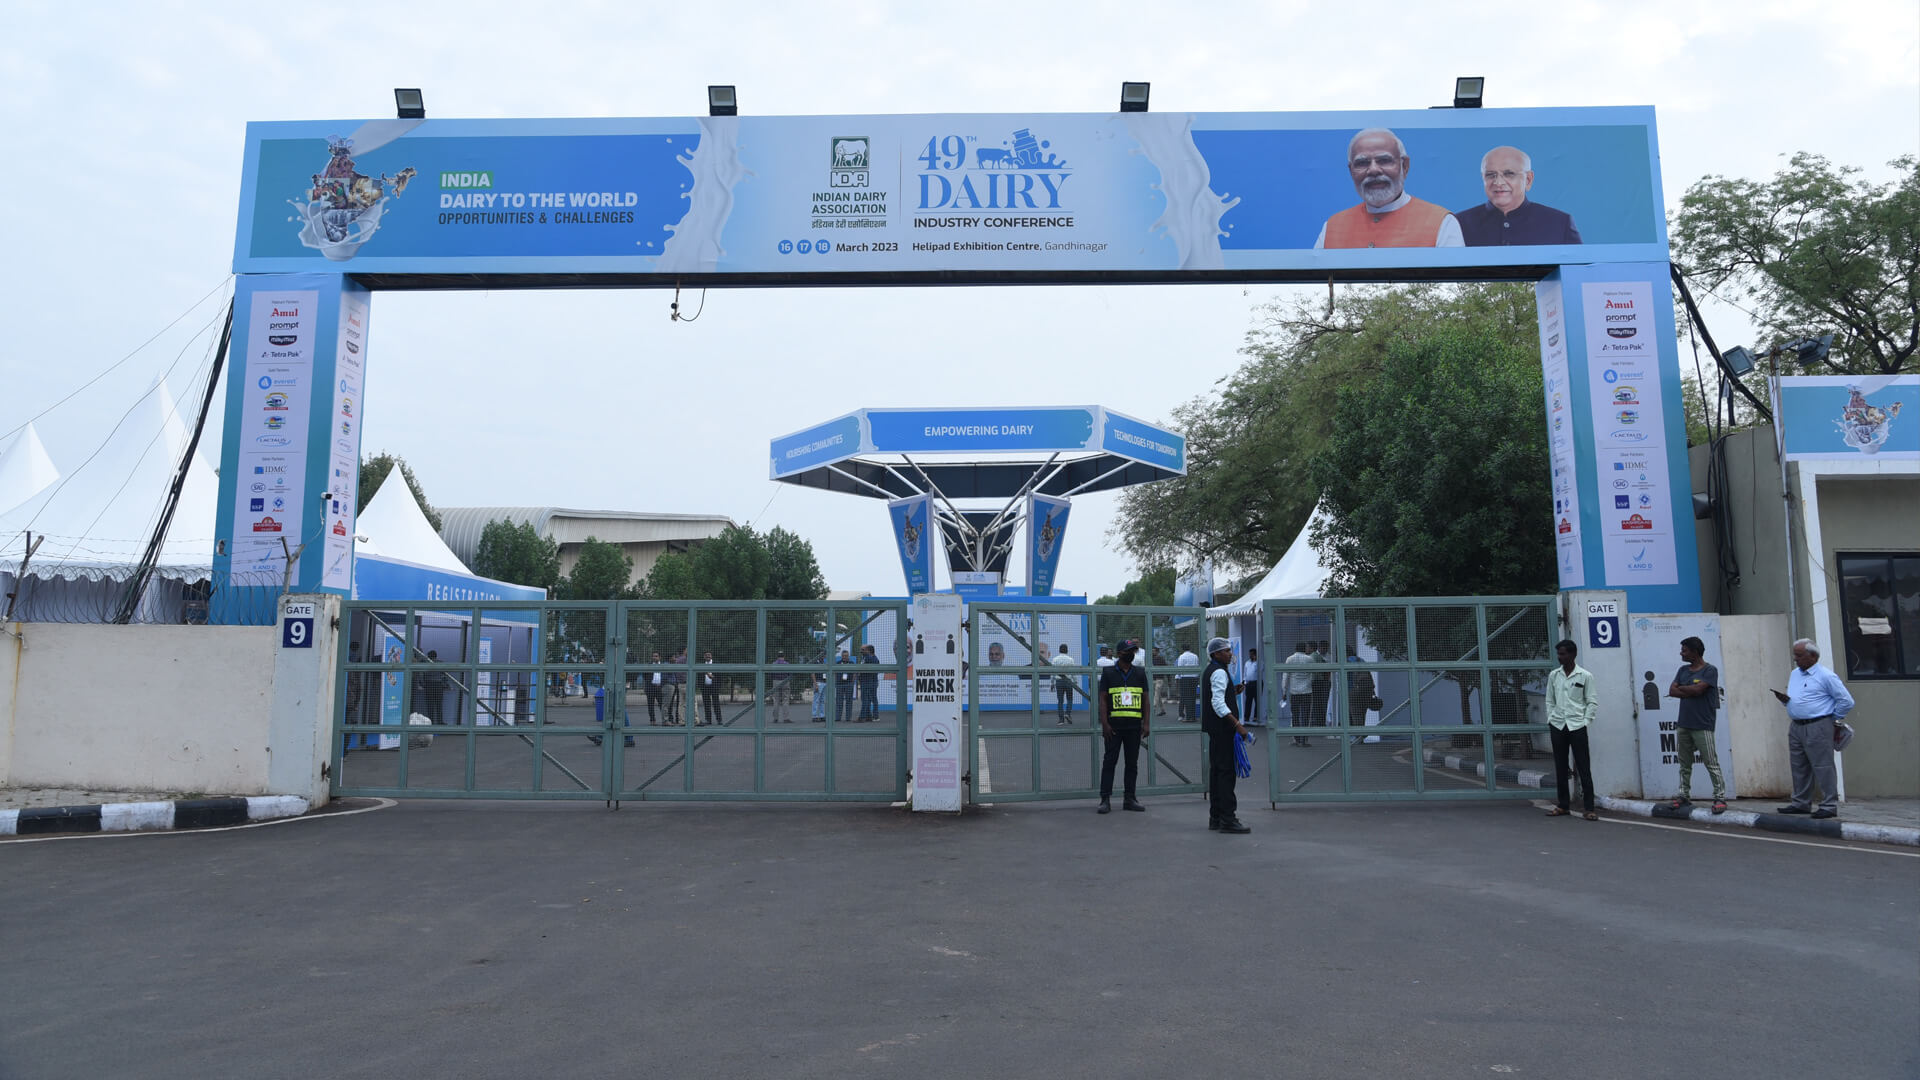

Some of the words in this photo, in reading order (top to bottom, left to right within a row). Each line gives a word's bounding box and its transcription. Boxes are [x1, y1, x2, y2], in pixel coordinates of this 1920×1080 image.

[441, 173, 491, 187] INDIA
[918, 173, 1073, 209] DAIRY
[440, 193, 498, 208] DAIRY
[500, 193, 525, 208] TO
[529, 192, 565, 208] THE
[569, 192, 638, 207] WORLD
[812, 192, 850, 202] INDIAN
[854, 192, 887, 202] DAIRY
[811, 204, 887, 214] ASSOCIATION
[438, 212, 535, 225] OPPORTUNITIES
[539, 212, 547, 224] &
[554, 211, 634, 224] CHALLENGES
[914, 217, 980, 228] INDUSTRY
[984, 217, 1074, 228] CONFERENCE
[836, 242, 869, 252] March
[871, 242, 898, 252] 2023
[912, 242, 950, 253] Helipad
[953, 241, 1003, 251] Exhibition
[1006, 242, 1042, 252] Centre,
[1045, 241, 1109, 253] Gandhinagar
[1605, 299, 1634, 309] Amul
[271, 308, 298, 317] Amul
[270, 322, 299, 330] prompt
[924, 425, 999, 437] EMPOWERING
[1001, 424, 1034, 436] DAIRY
[265, 465, 286, 473] IDMC
[286, 606, 311, 614] GATE
[1589, 605, 1615, 613] GATE
[1009, 619, 1048, 631] DAIY
[290, 621, 306, 644] 9
[1596, 620, 1613, 644] 9
[916, 669, 935, 677] WEAR
[937, 669, 955, 677] YOUR
[916, 679, 954, 693] MASK
[1114, 695, 1141, 708] SEITY
[1659, 721, 1678, 731] WEA
[1663, 755, 1672, 764] AT
